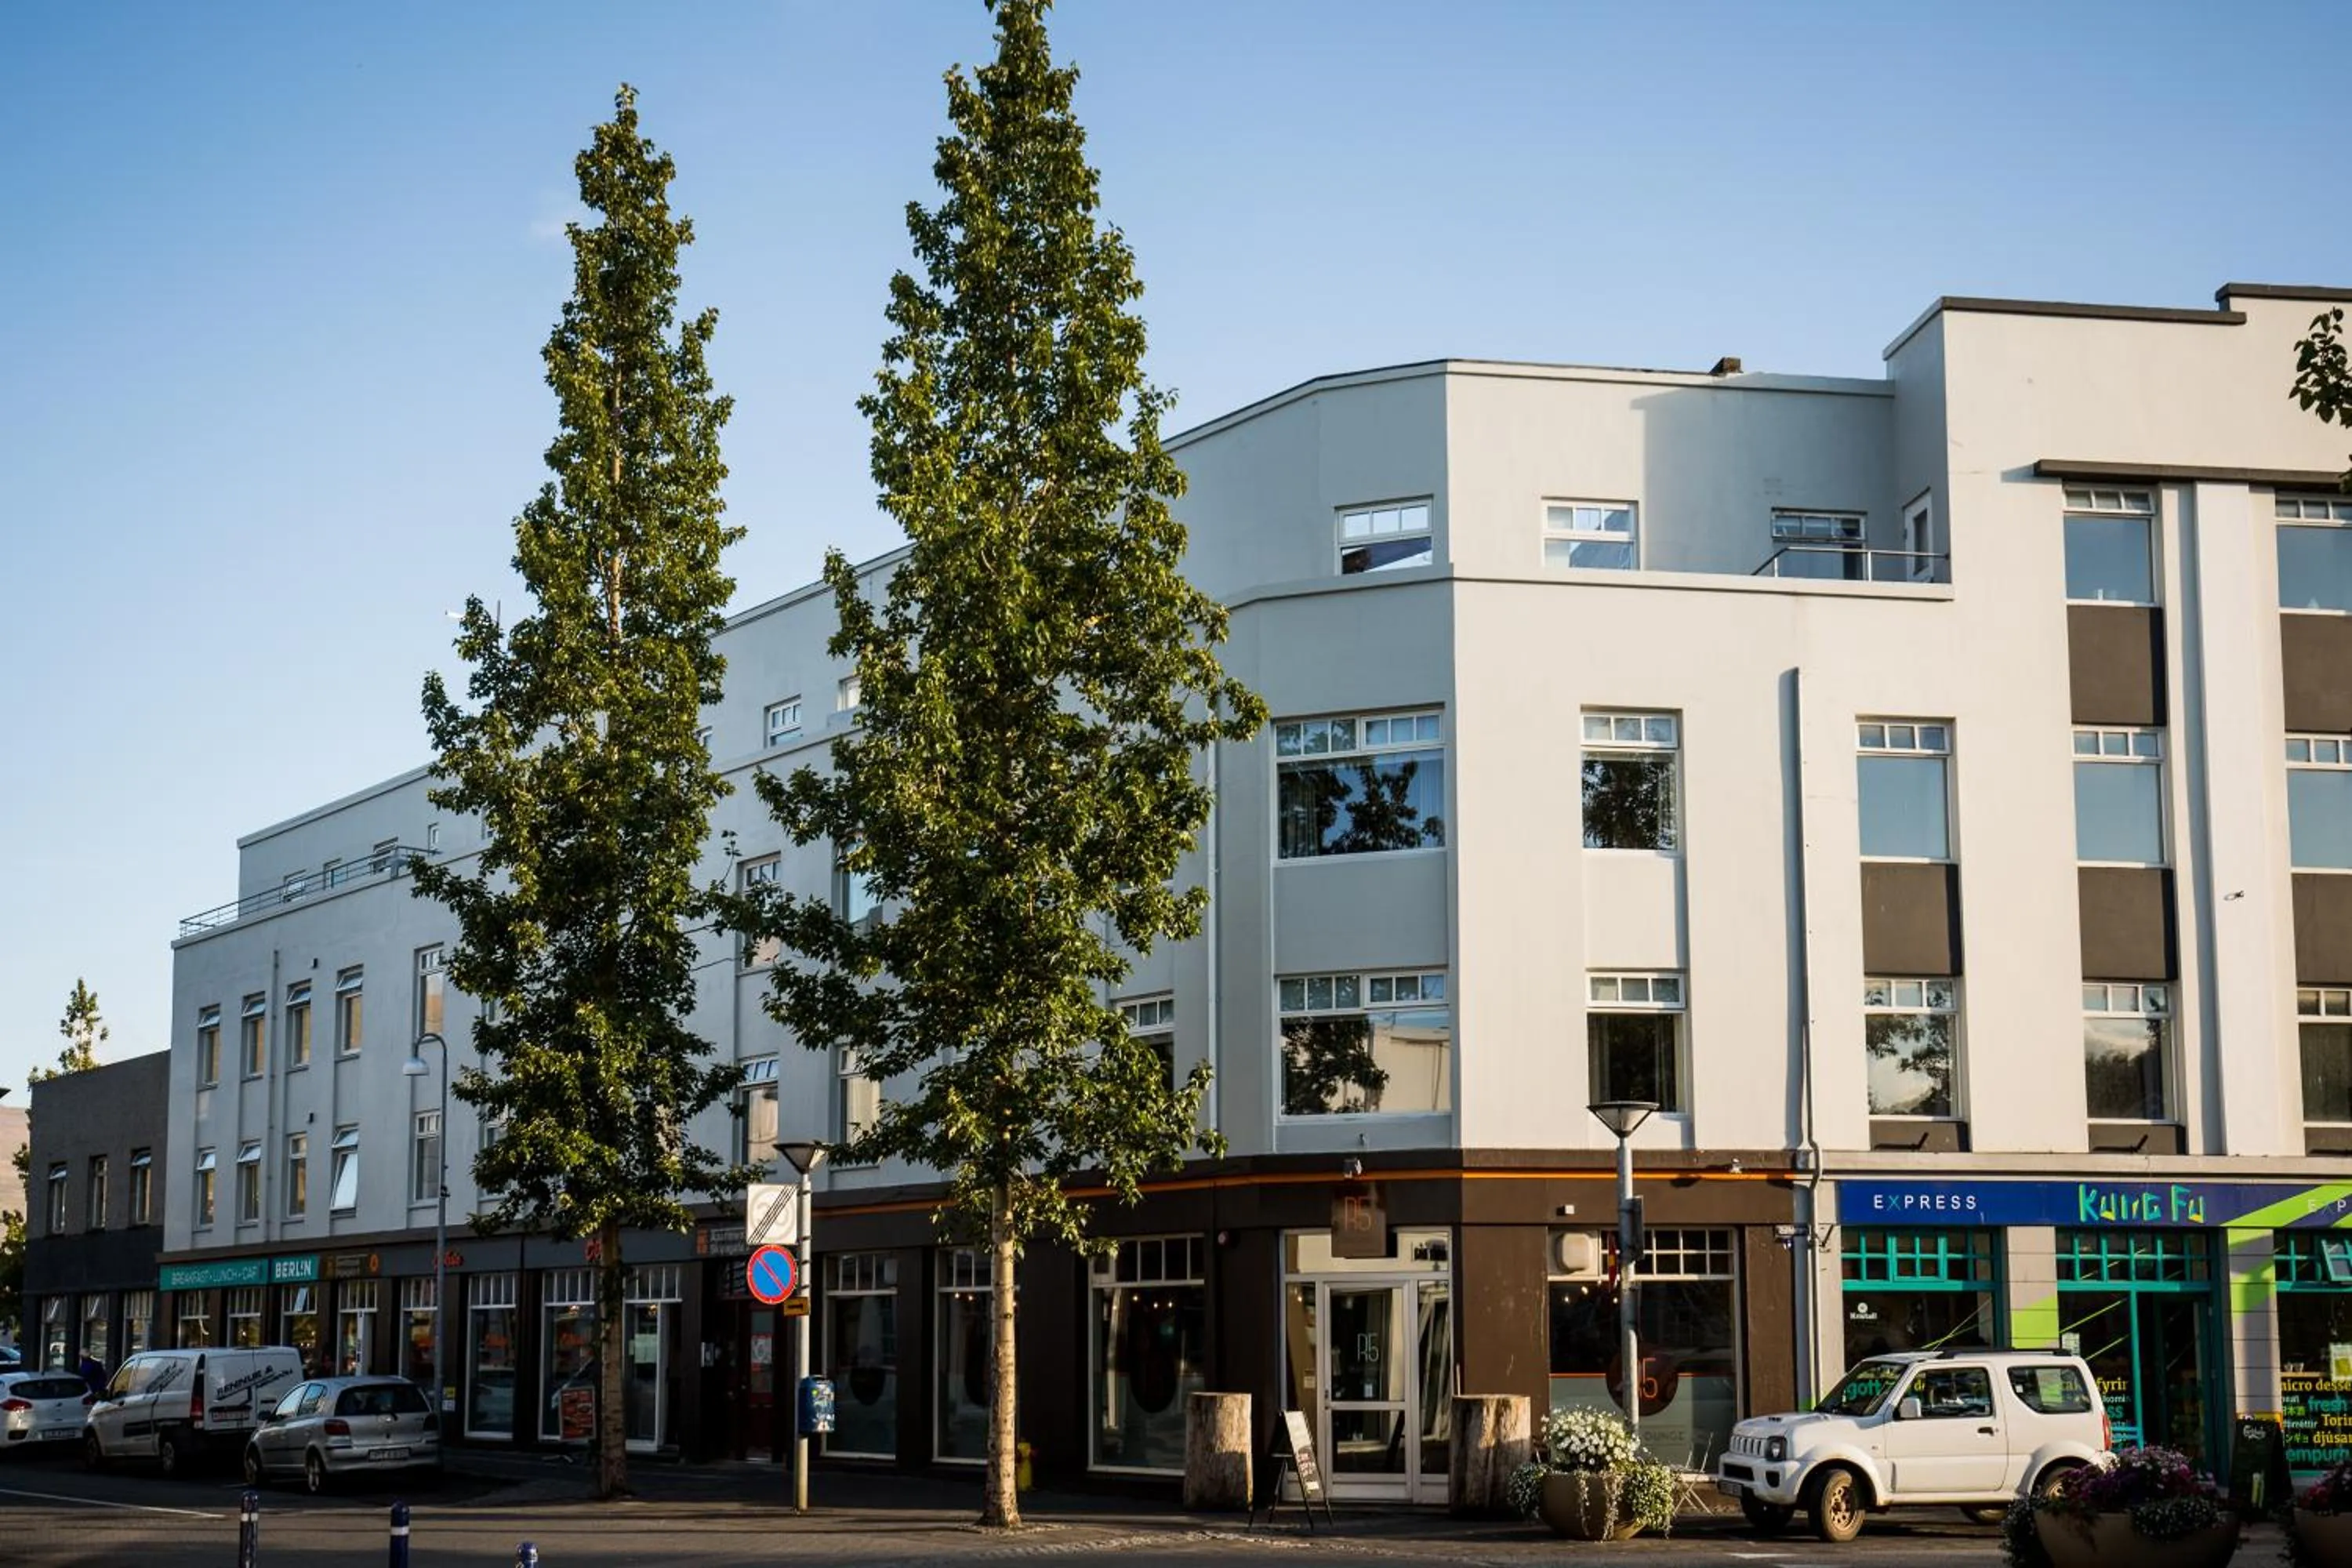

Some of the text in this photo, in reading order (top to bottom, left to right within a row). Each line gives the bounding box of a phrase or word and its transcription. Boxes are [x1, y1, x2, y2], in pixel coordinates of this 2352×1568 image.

[1873, 1194, 1977, 1210] EXPRESS
[1356, 1332, 1380, 1363] R5
[2307, 1395, 2348, 1412] fresh
